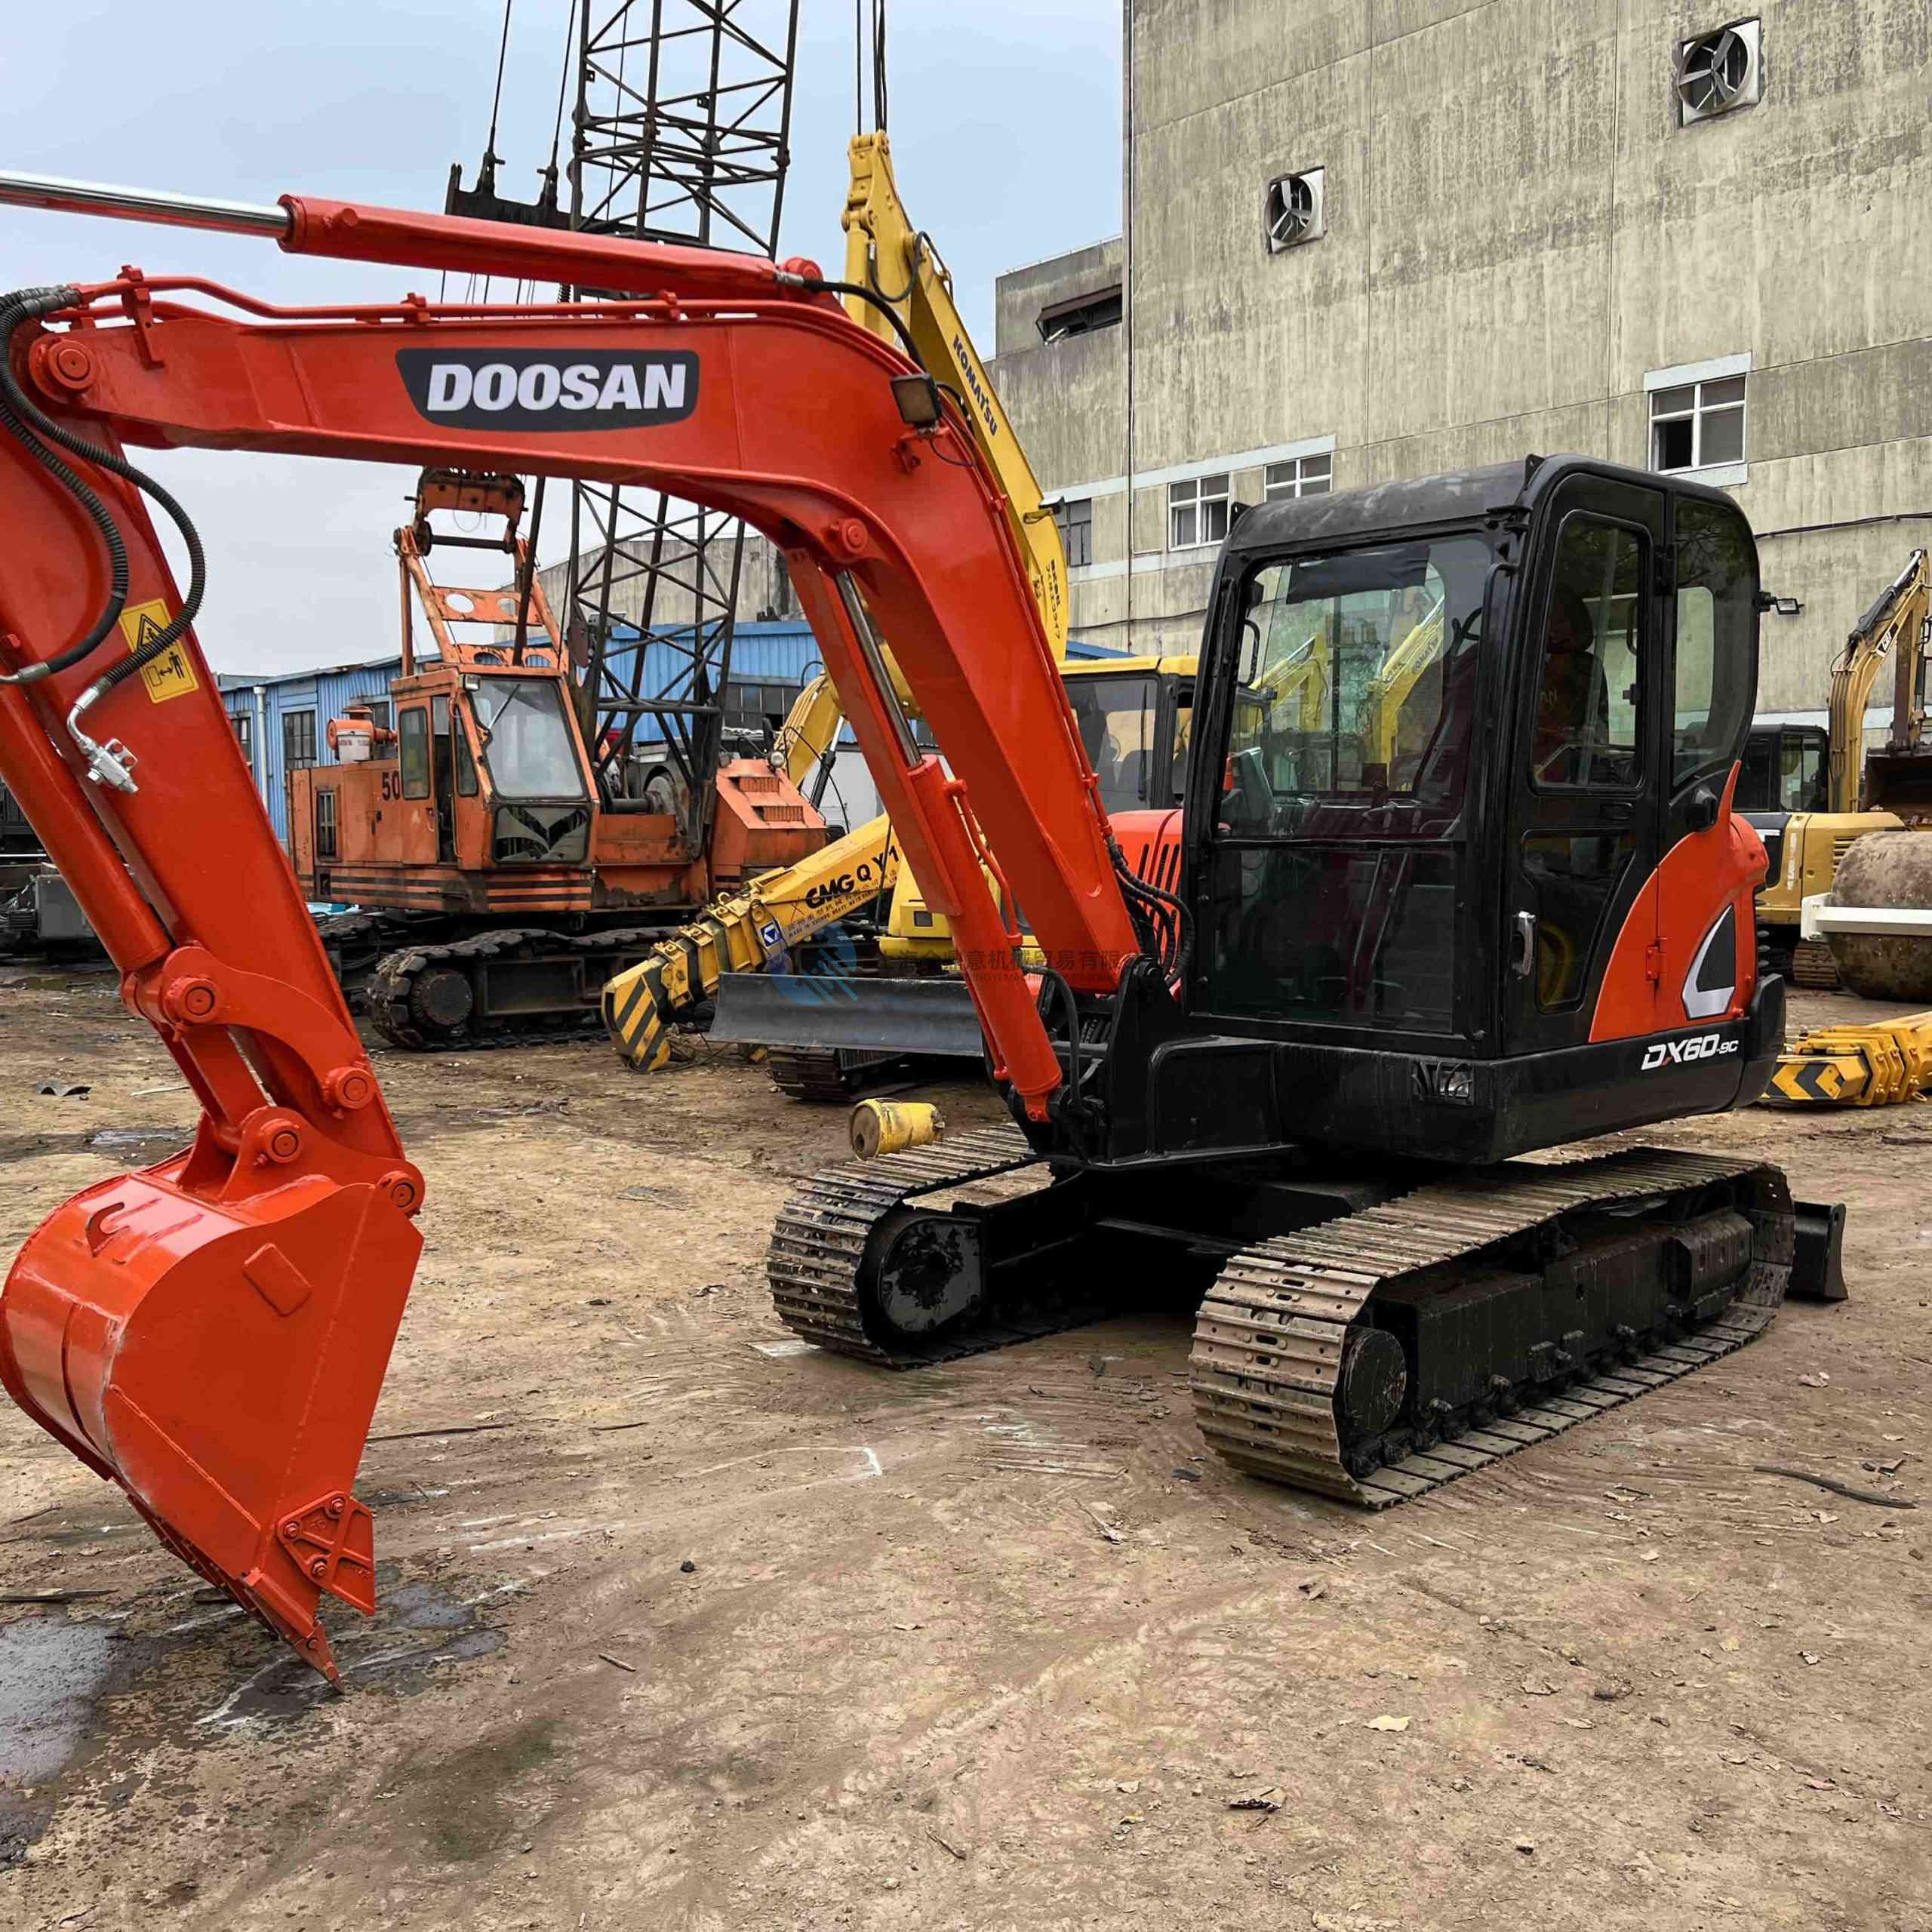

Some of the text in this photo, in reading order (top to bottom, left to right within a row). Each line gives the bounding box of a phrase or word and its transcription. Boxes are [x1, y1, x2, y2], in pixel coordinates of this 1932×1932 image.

[426, 362, 687, 412] DOOSAN
[952, 334, 998, 436] KOMATSU
[381, 771, 401, 801] 50
[1641, 1033, 1739, 1071] DX60-9C
